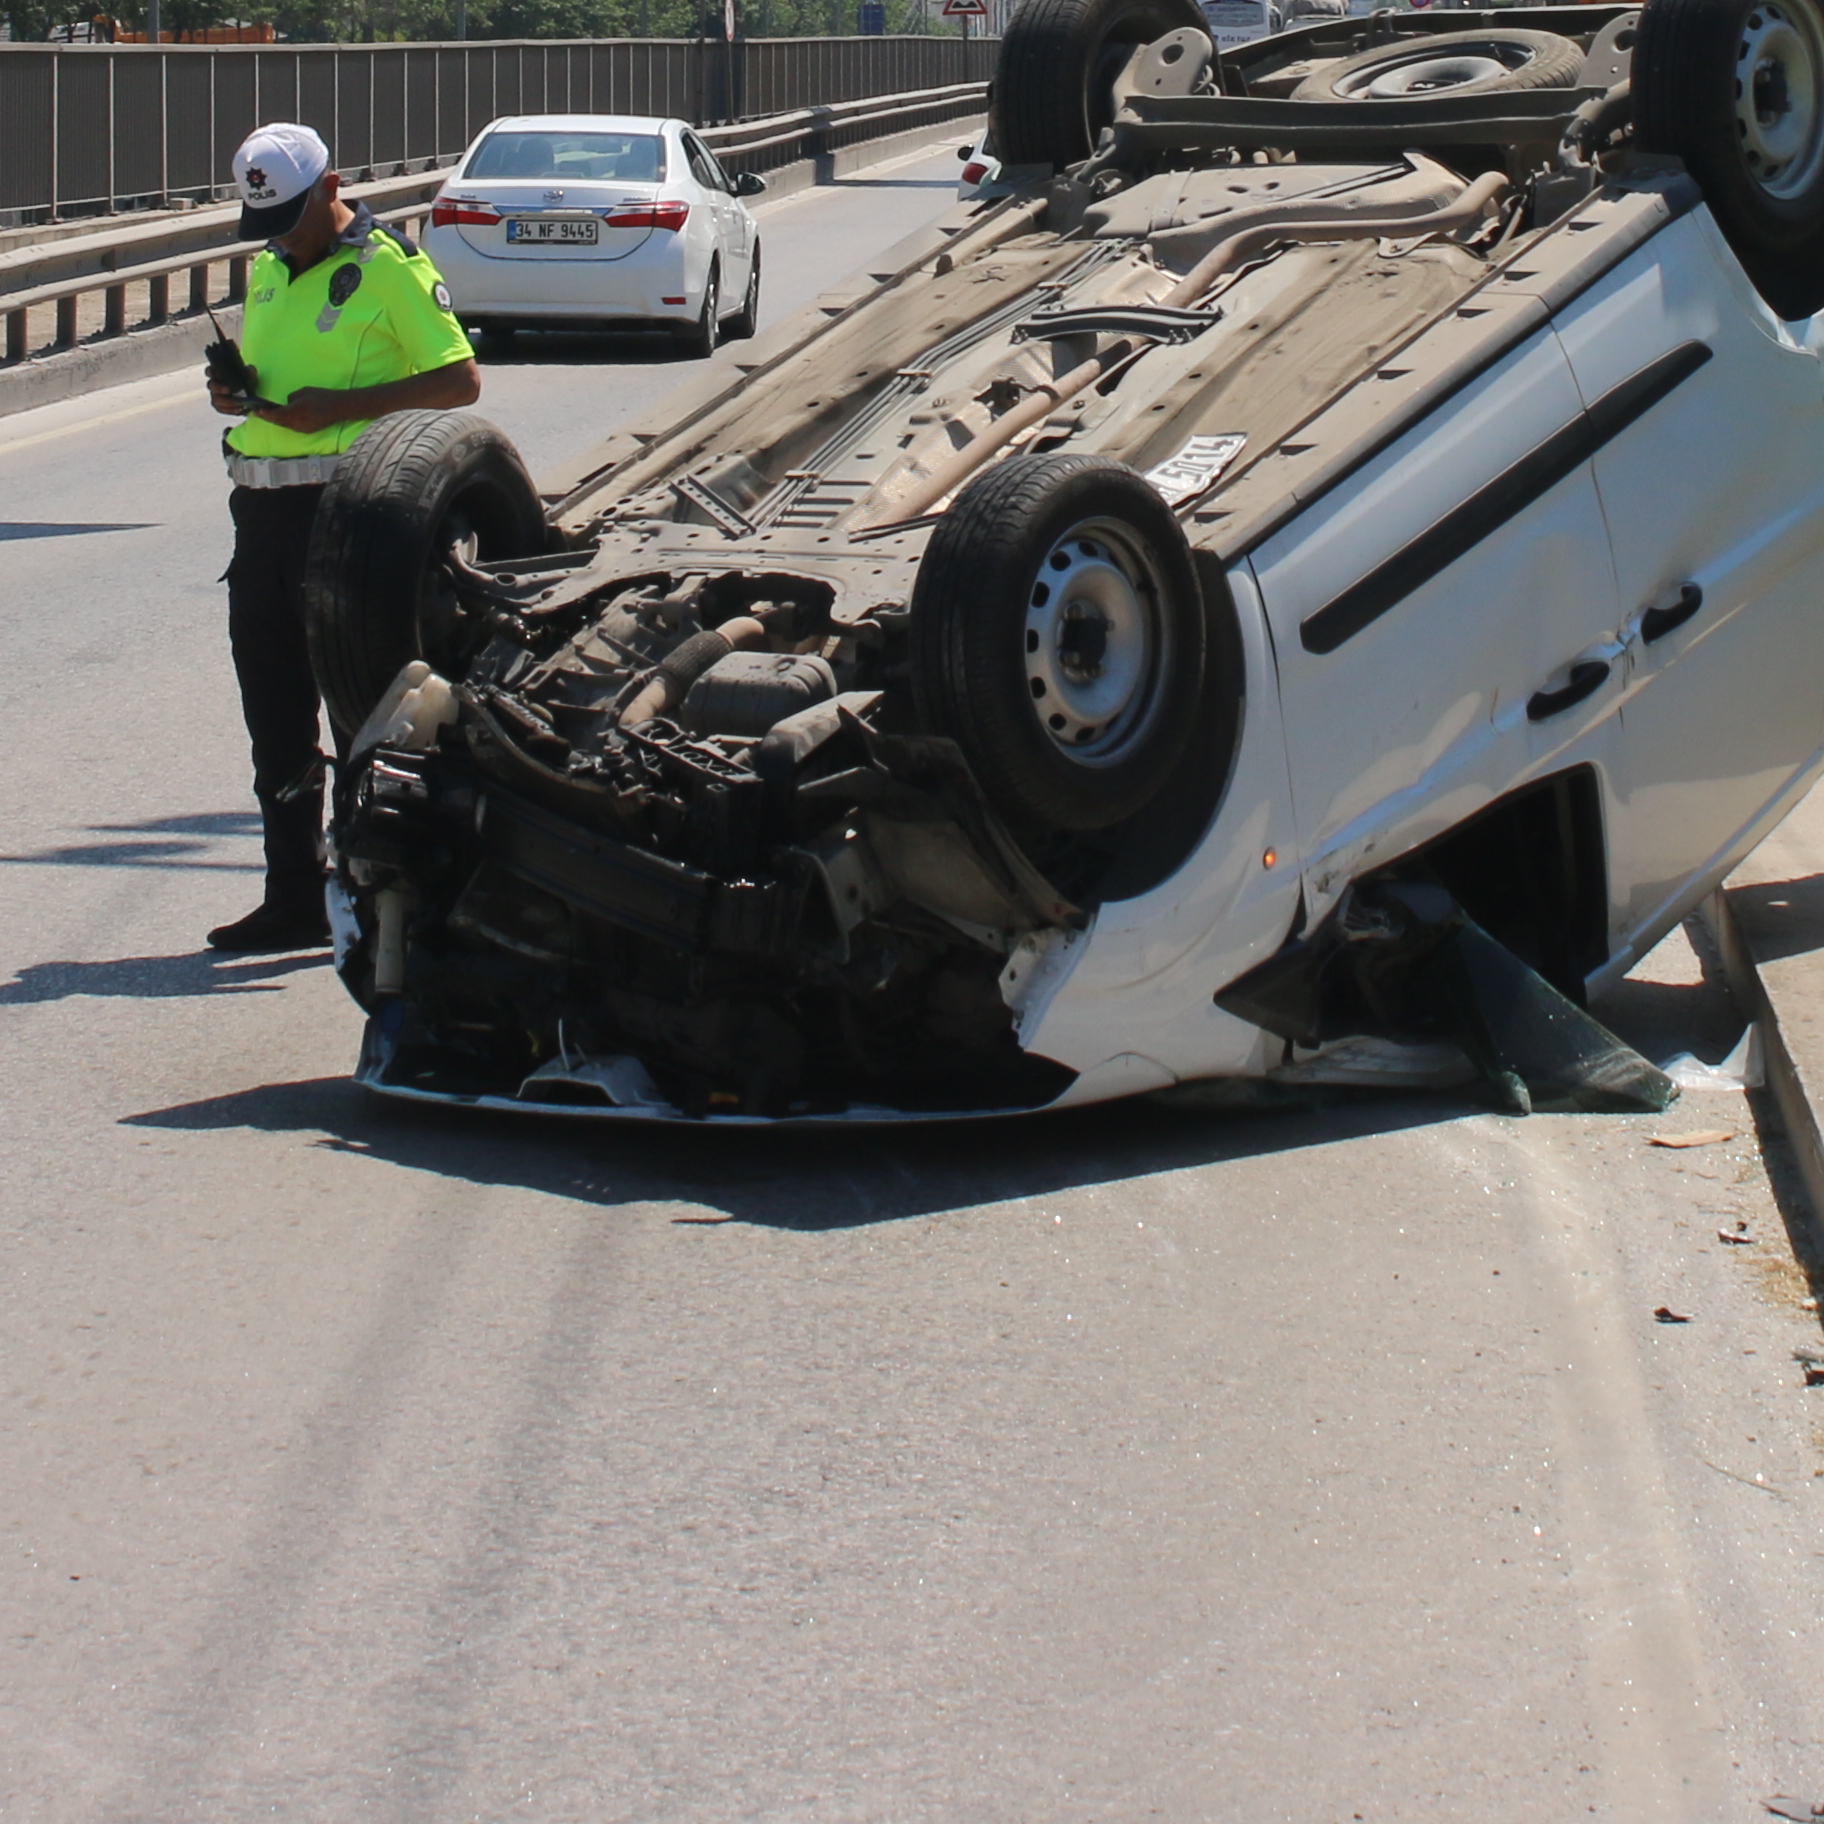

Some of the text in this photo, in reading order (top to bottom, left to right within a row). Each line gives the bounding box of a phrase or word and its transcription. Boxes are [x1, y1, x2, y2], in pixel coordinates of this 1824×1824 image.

[516, 223, 594, 239] 34 NF 9445
